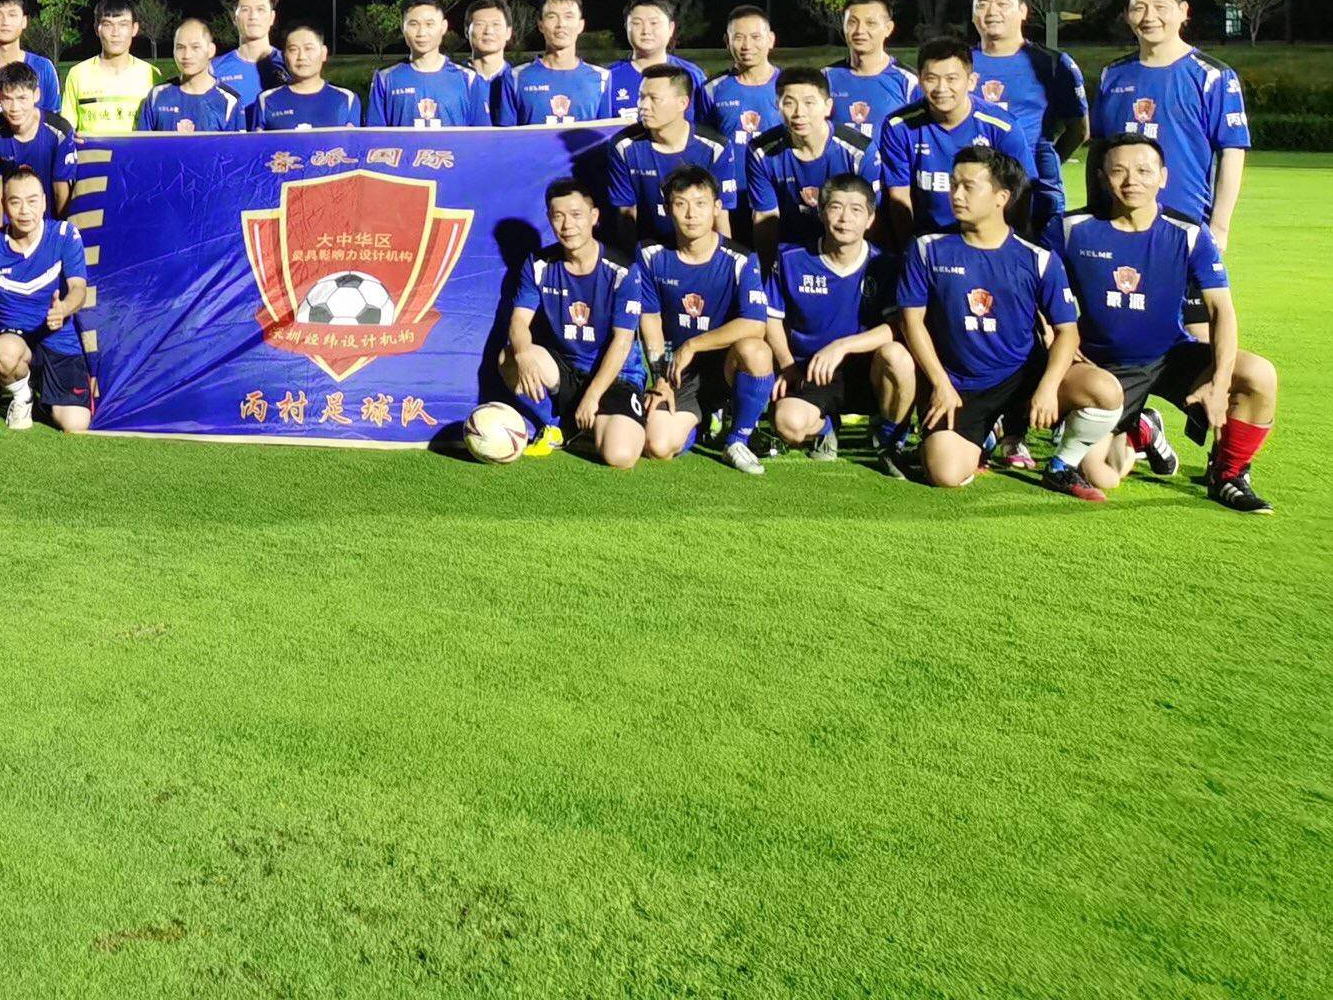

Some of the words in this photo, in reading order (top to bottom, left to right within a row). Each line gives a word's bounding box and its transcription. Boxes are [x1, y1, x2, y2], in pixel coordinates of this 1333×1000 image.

[315, 232, 393, 248] 大中华区
[1079, 249, 1113, 259] KELME
[933, 265, 965, 275] KELME
[240, 391, 437, 427] 丙村足球队
